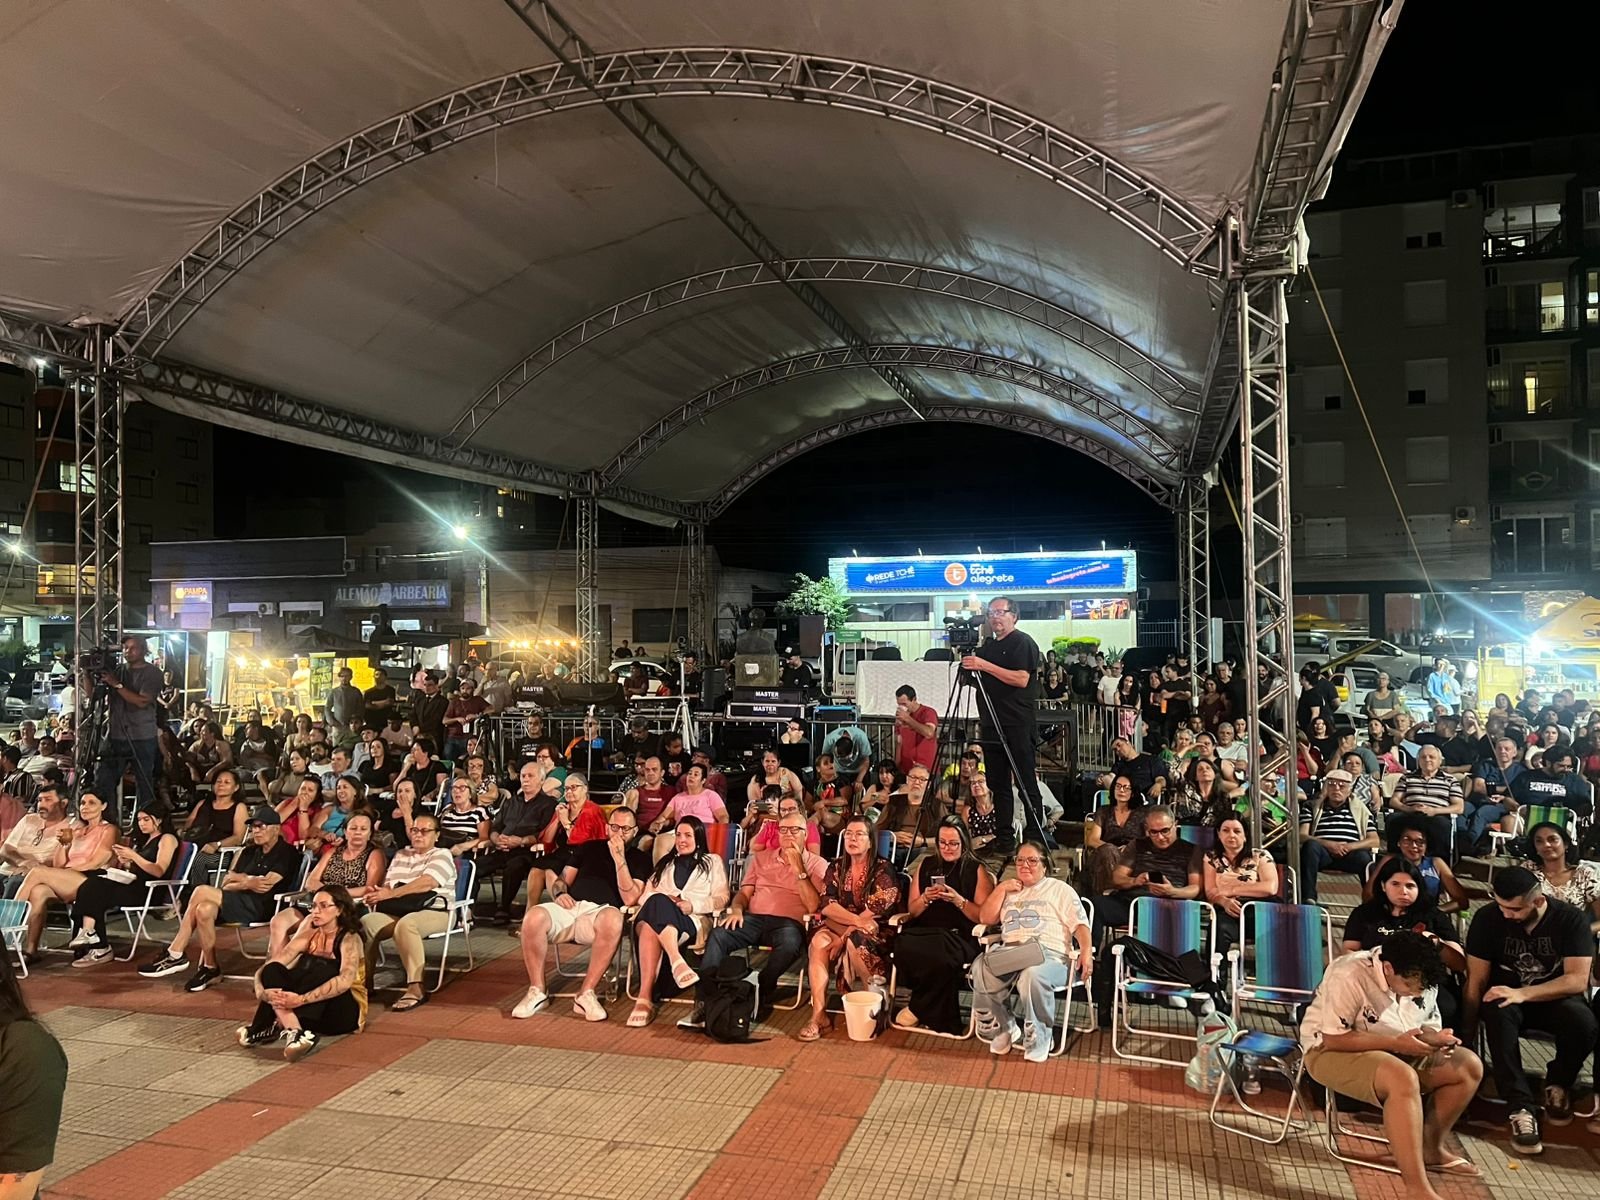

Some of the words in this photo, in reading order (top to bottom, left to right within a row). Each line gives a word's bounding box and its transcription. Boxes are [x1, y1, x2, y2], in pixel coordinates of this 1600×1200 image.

[874, 571, 895, 581] REDE
[970, 574, 1014, 584] alegrete
[185, 587, 207, 595] PAMPA
[336, 585, 379, 603] ALEMÃO
